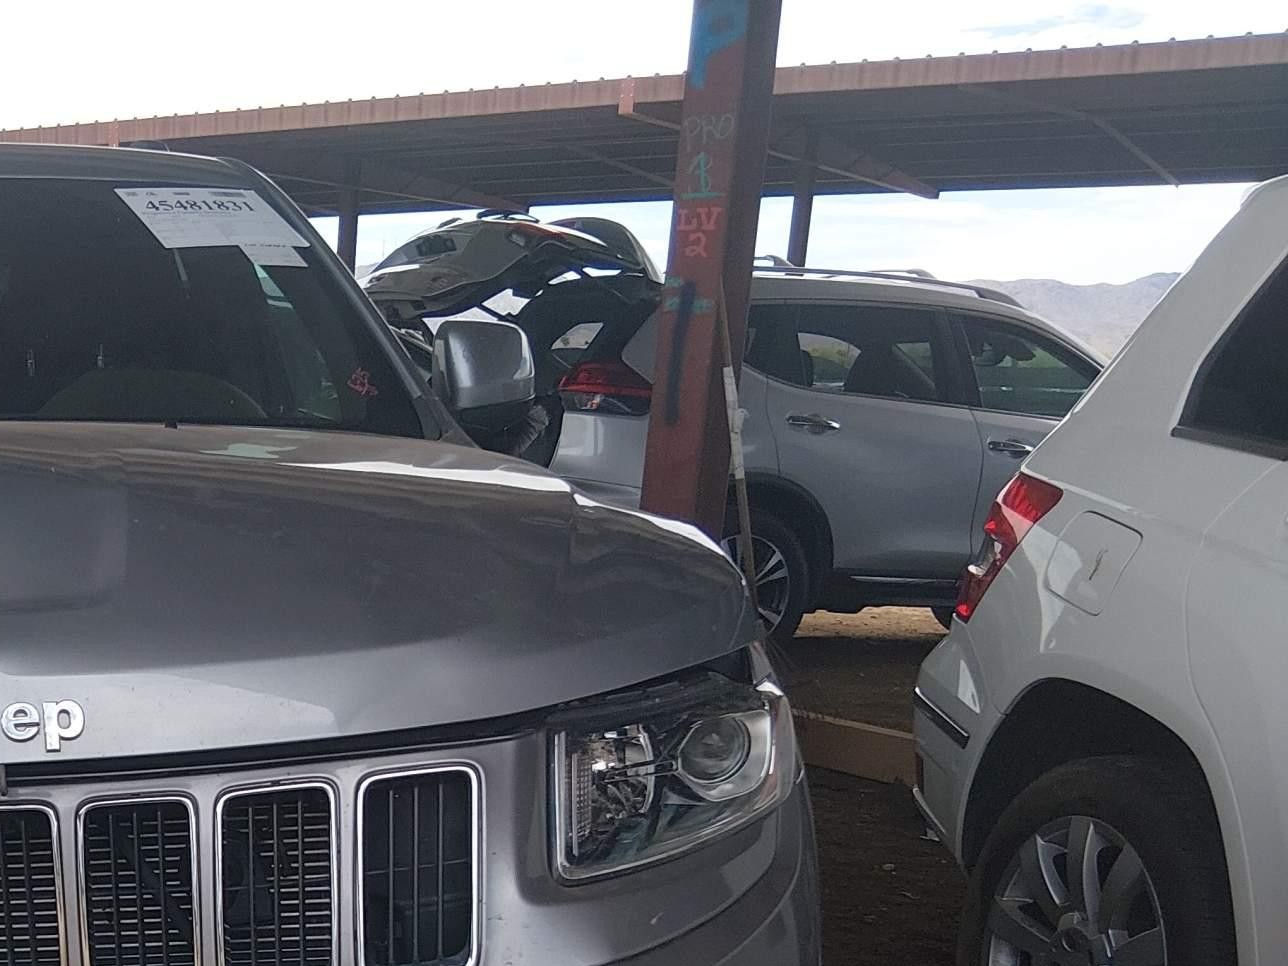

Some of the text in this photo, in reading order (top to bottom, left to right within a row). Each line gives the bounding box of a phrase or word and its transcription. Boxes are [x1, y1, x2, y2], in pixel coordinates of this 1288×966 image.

[145, 200, 256, 212] 45481831
[677, 207, 723, 231] LV
[684, 231, 708, 258] 2
